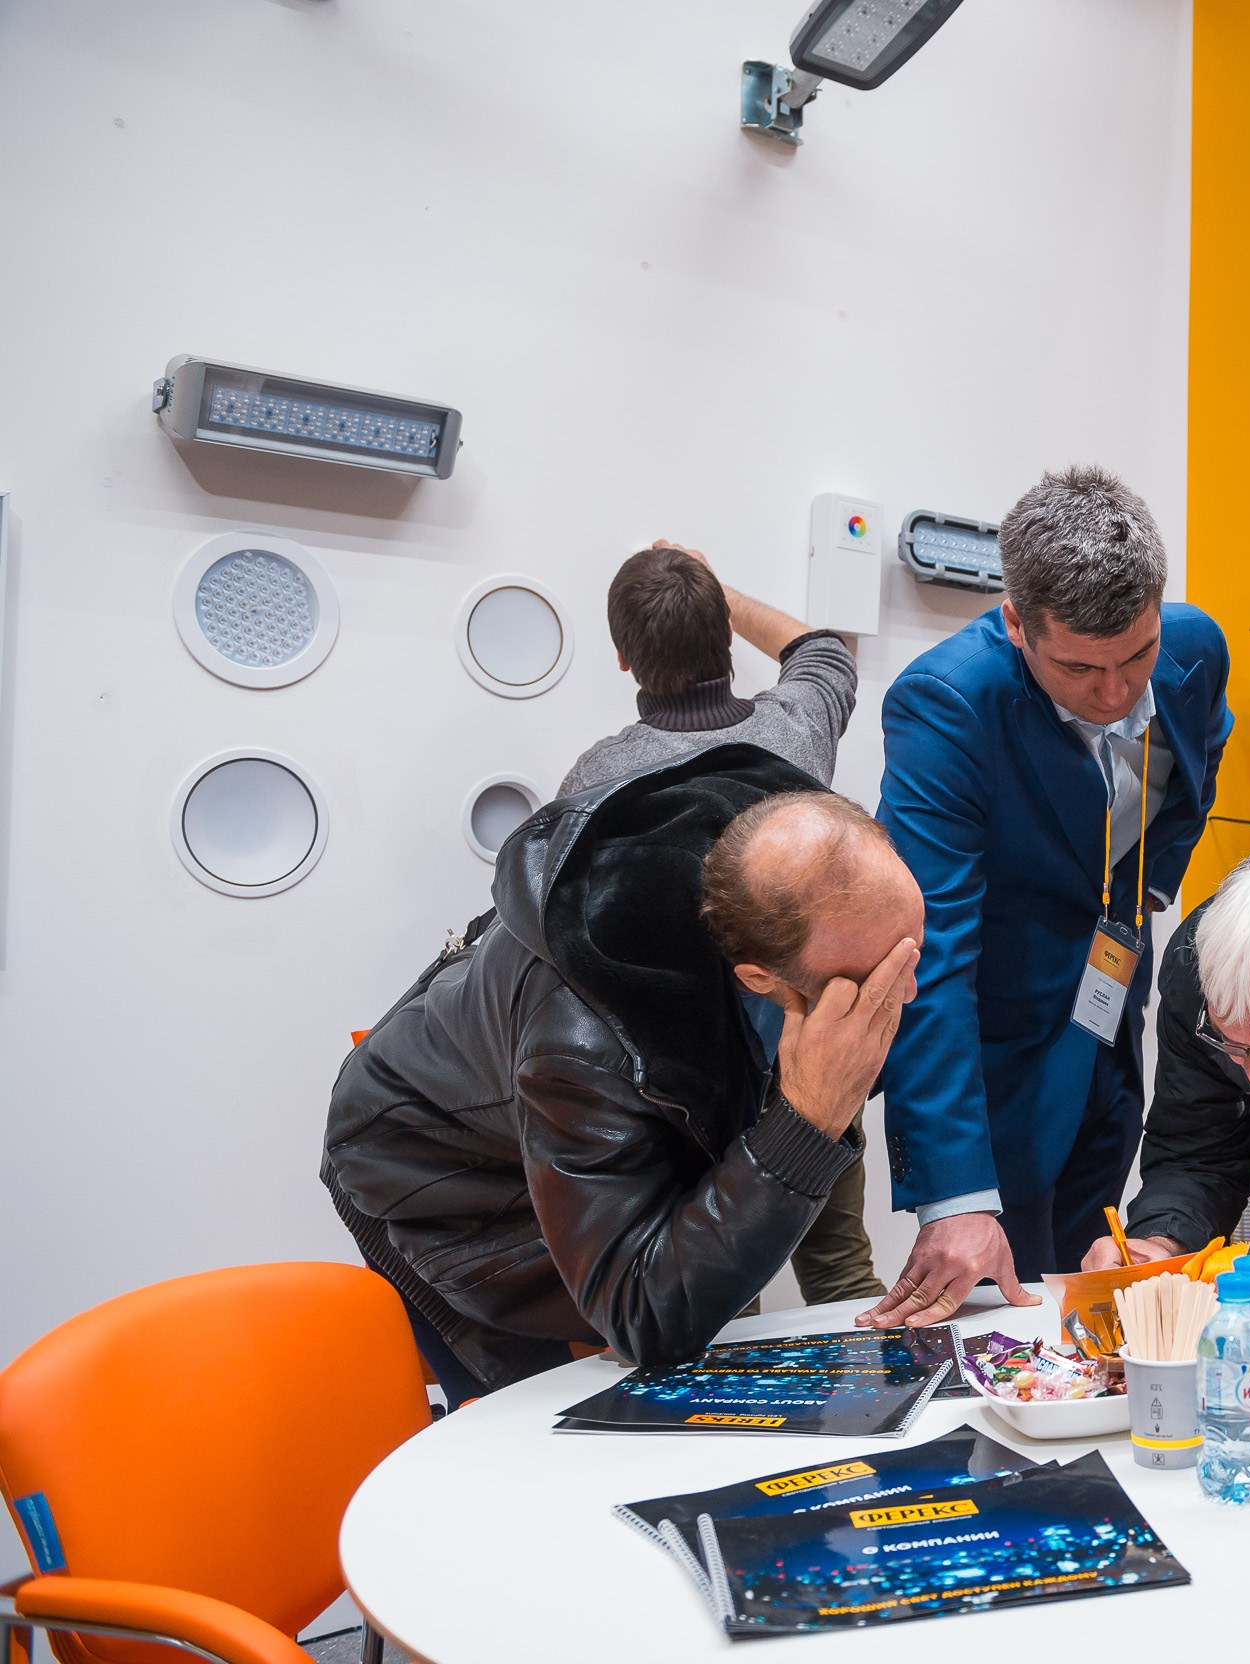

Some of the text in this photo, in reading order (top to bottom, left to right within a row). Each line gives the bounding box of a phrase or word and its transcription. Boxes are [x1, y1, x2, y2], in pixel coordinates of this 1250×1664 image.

[766, 1464, 868, 1490] ФЕРЕКС
[859, 1503, 971, 1523] ФЕРЕКС
[861, 1530, 1000, 1555] О КОМПАНИИ
[818, 1570, 1098, 1616] ХОРОШИЙ СВЕТ ДОСТУПЕН КАЖДОМУ
